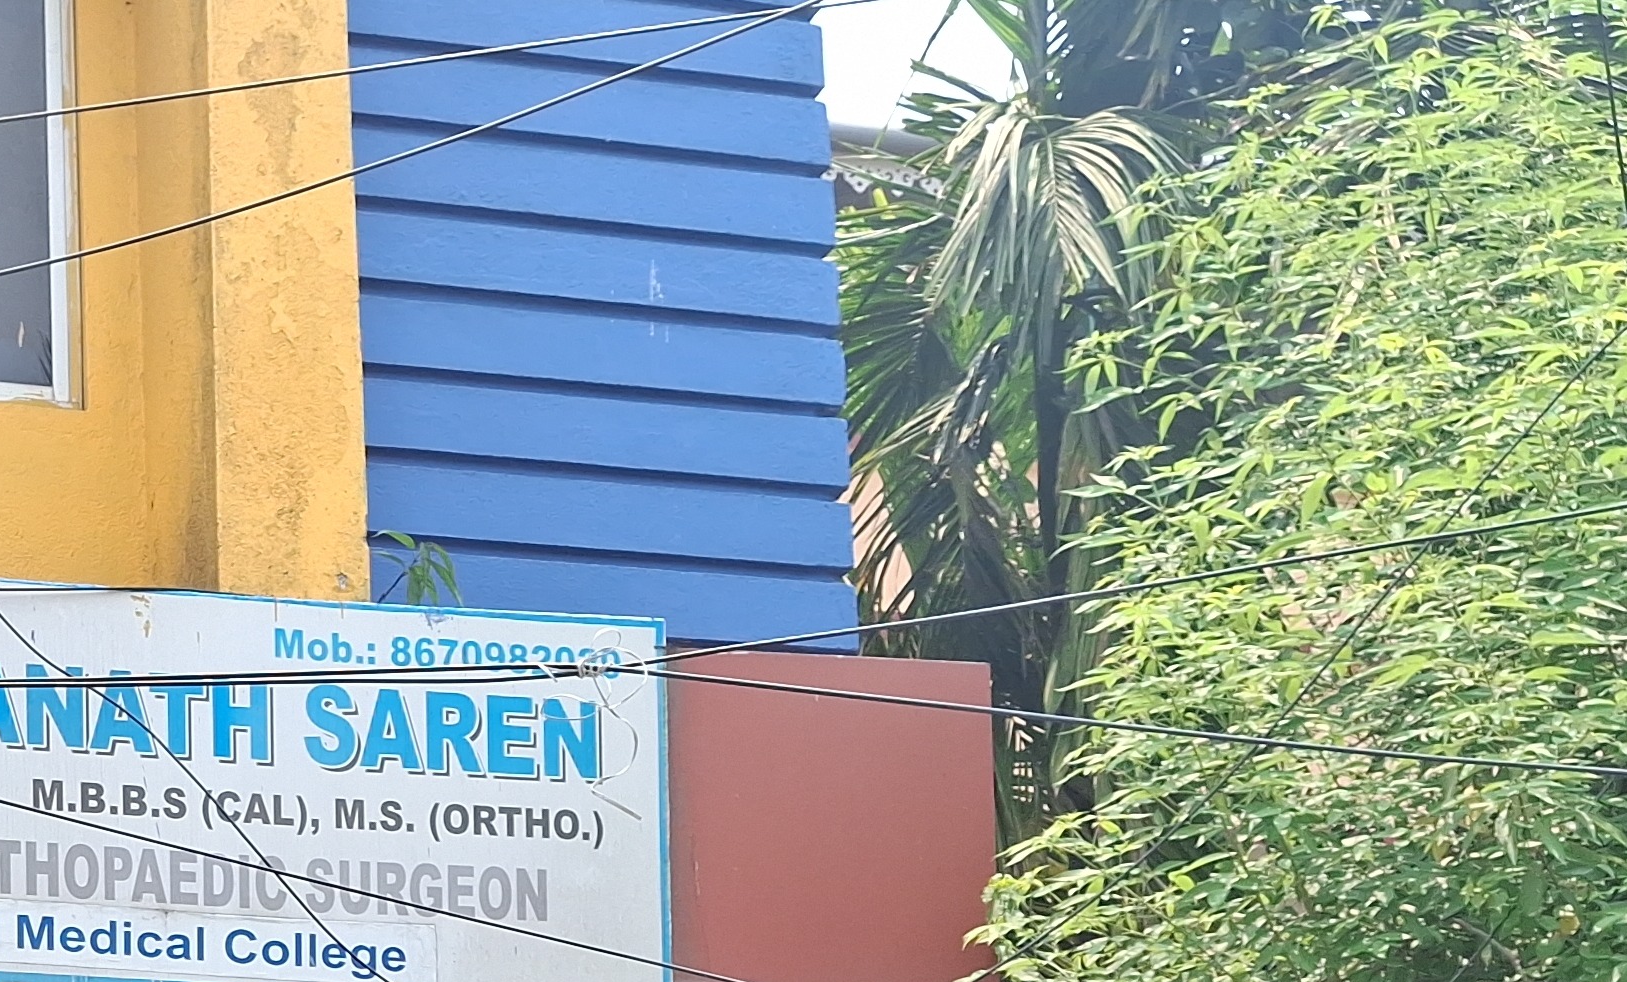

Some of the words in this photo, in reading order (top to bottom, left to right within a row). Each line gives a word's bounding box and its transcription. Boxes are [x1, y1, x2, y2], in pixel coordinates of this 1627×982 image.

[274, 628, 377, 665] Mob.:
[305, 685, 605, 783] SAREN
[32, 779, 187, 820] M.B.B.S
[202, 787, 320, 836] (CAL),
[334, 799, 415, 832] M.S.
[429, 802, 605, 849] (ORTHO.)
[306, 859, 549, 921] SURGEON
[17, 914, 205, 962] Medical
[225, 926, 408, 979] College
